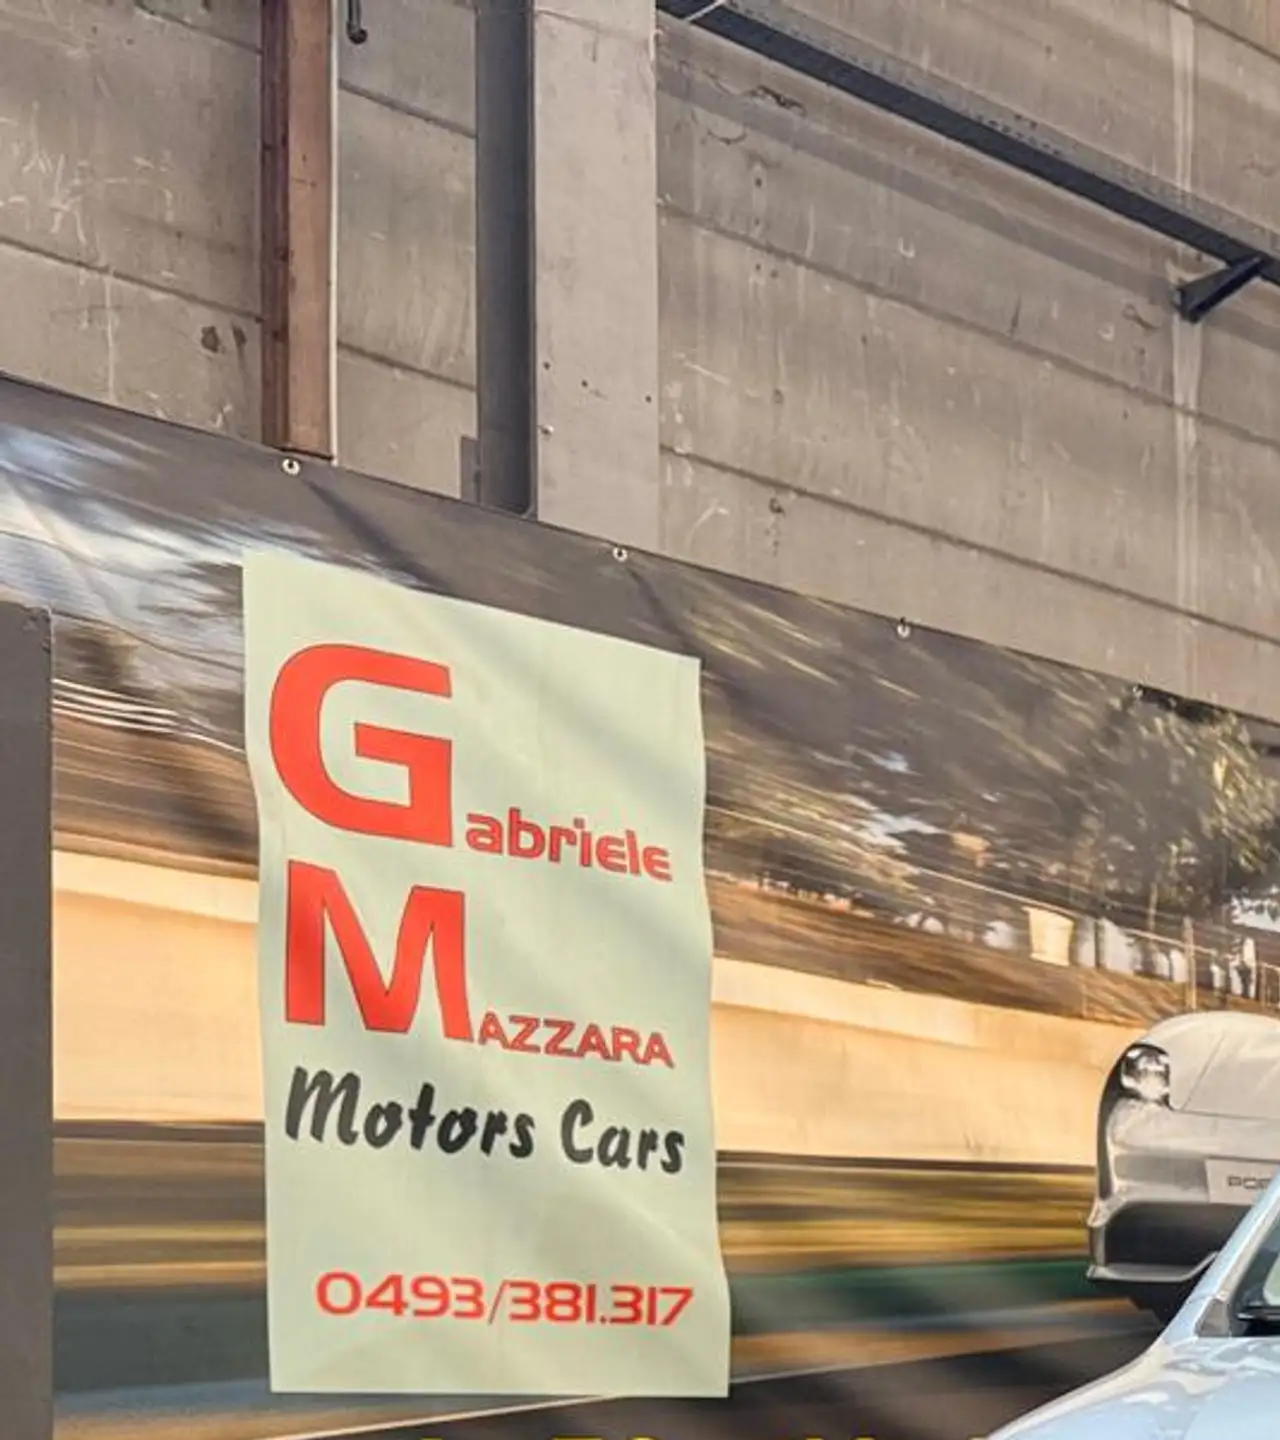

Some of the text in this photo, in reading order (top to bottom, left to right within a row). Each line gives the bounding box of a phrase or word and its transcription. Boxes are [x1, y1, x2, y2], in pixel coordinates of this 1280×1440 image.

[270, 645, 673, 882] Gabriele
[284, 1066, 685, 1175] Motors Cars
[314, 1271, 694, 1328] 0493/381.317
